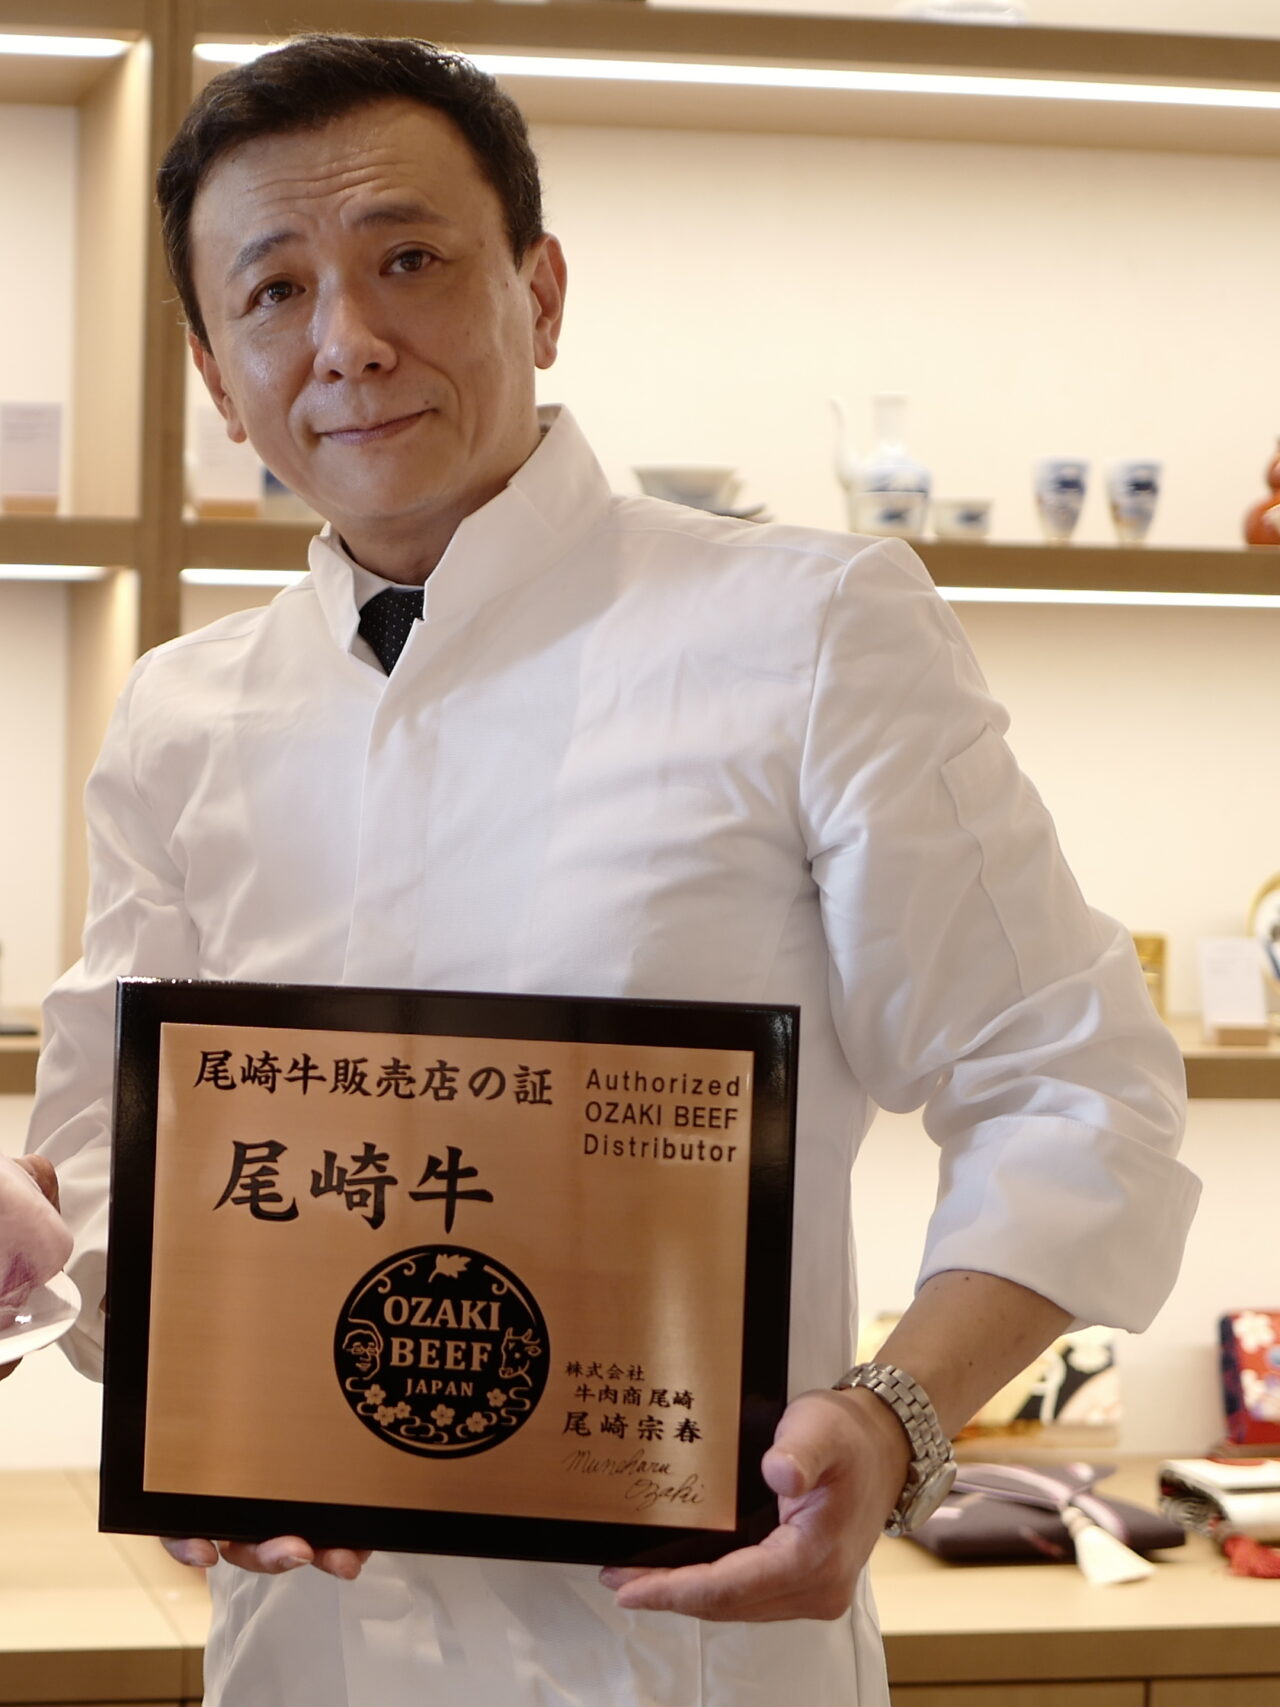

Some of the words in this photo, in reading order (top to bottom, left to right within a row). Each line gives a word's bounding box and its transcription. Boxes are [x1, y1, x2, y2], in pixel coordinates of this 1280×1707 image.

[193, 1049, 554, 1106] 尾崎牛販売店の証
[585, 1068, 741, 1097] Authorized
[584, 1101, 662, 1126] OZAKI
[673, 1105, 739, 1130] BEEF
[583, 1132, 737, 1163] Distributor
[212, 1139, 494, 1235] 尾崎牛
[383, 1295, 501, 1331] OZAKI
[389, 1336, 493, 1372] BEEF
[404, 1377, 474, 1397] JAPAN
[565, 1360, 646, 1382] 株式会社
[562, 1411, 703, 1444] 尾崎宗春
